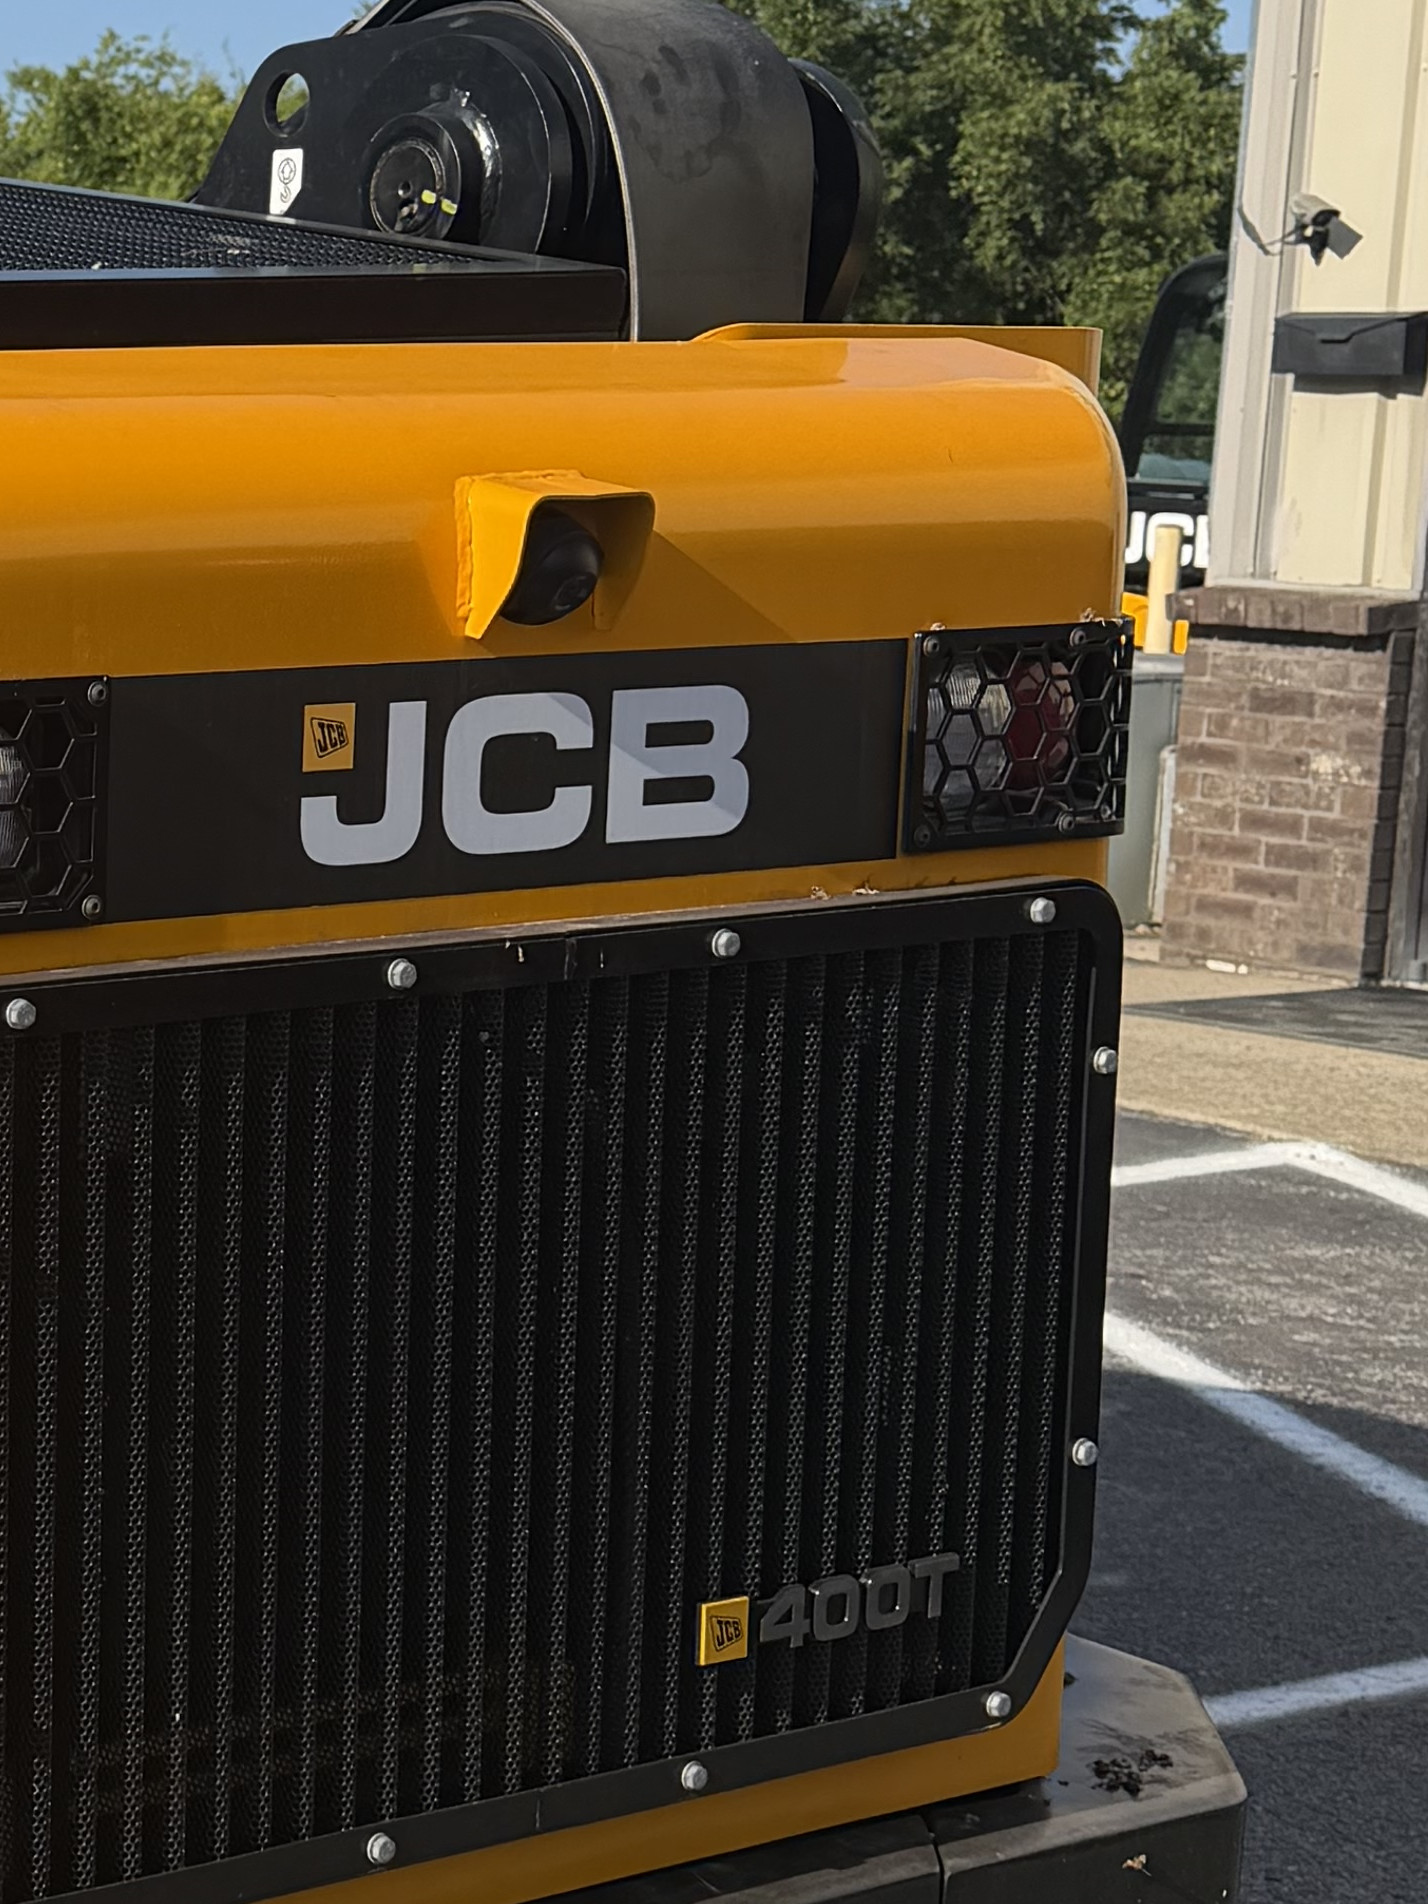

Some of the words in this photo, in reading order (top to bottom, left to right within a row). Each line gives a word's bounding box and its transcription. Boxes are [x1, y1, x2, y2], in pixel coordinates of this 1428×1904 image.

[317, 721, 346, 753] JCB
[300, 684, 750, 867] JCB
[759, 1551, 960, 1648] 400T
[716, 1619, 742, 1647] JCB
